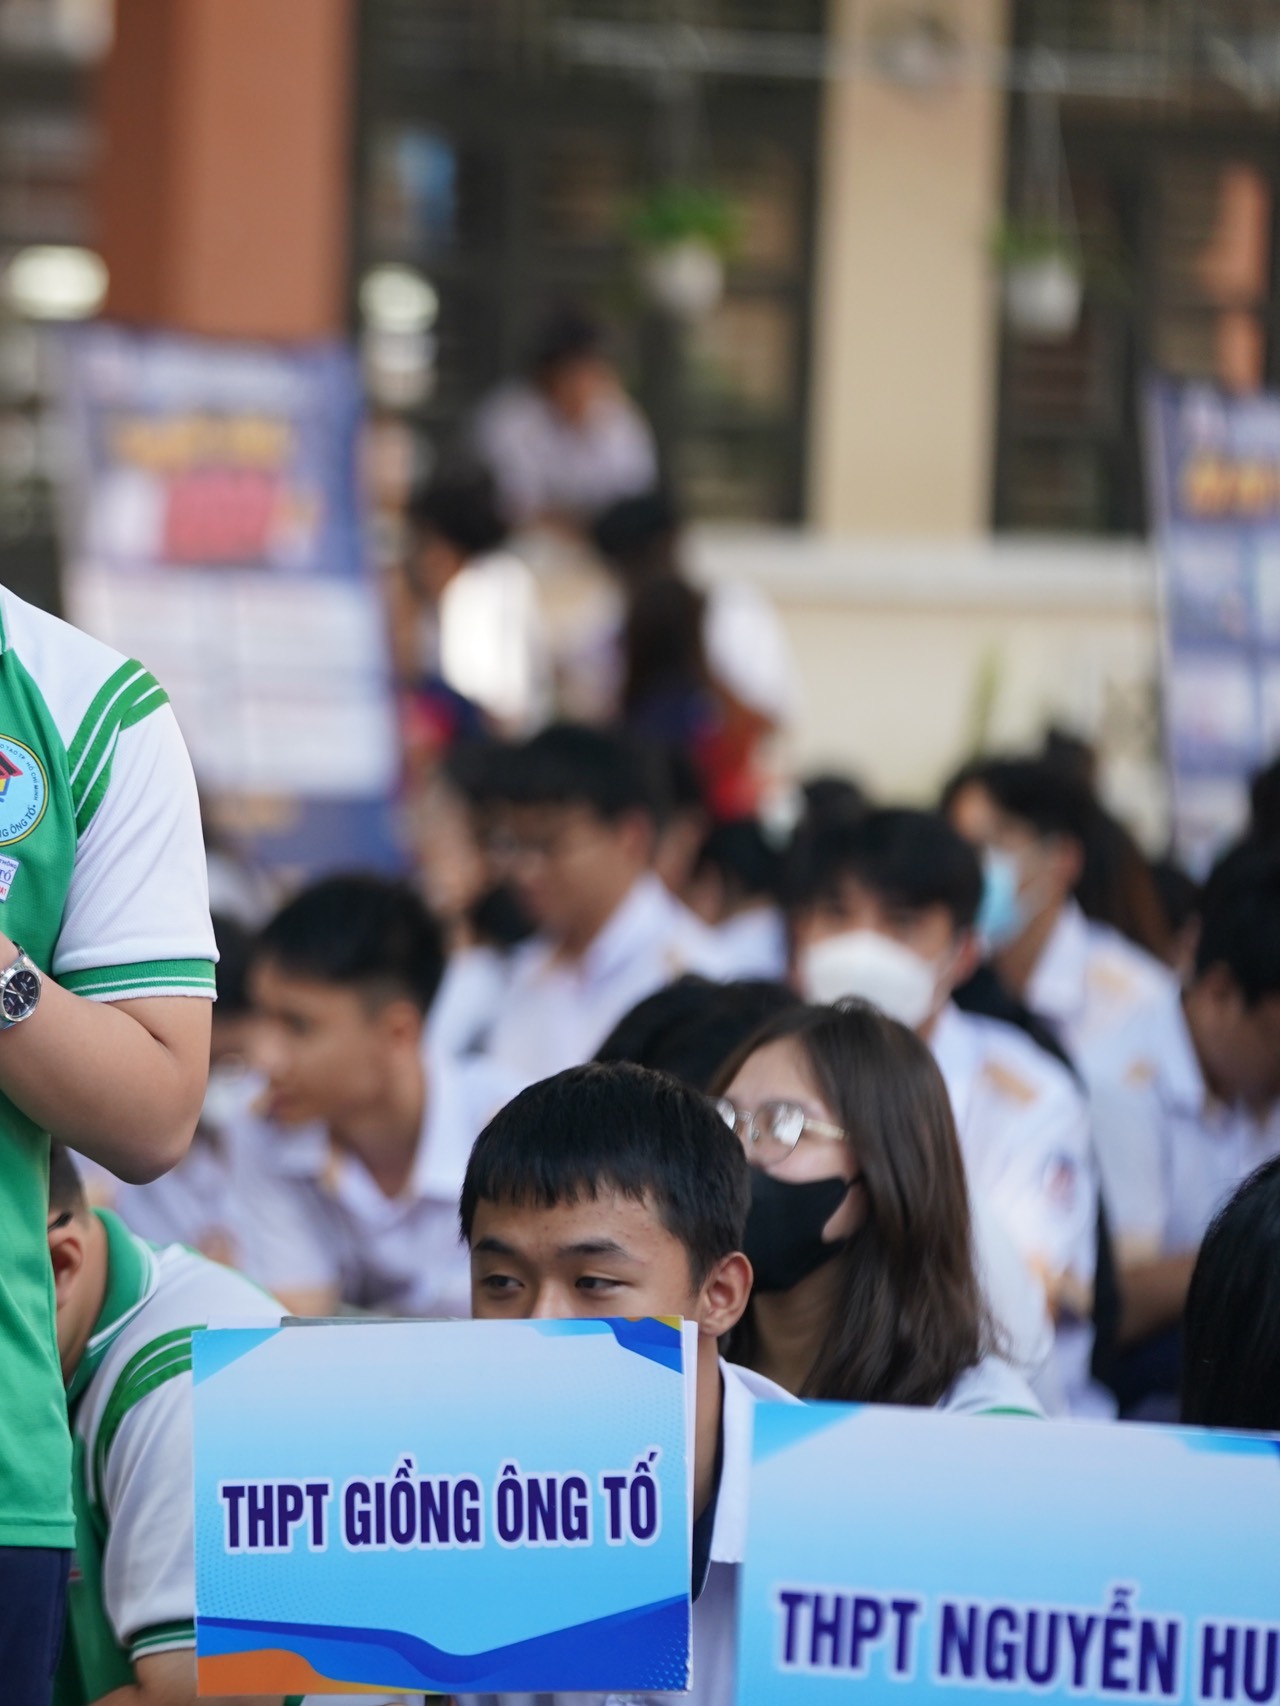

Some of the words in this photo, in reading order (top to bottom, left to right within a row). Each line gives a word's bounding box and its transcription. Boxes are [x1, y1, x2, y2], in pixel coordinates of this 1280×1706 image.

[10, 819, 28, 834] ÔNG
[222, 1483, 329, 1548] THPT
[344, 1459, 481, 1546] GIỒNG
[496, 1464, 588, 1545] ÔNG
[603, 1451, 658, 1540] TỐ
[780, 1591, 918, 1672] THPT
[940, 1587, 1178, 1695] NGUYỄN
[1202, 1624, 1279, 1703] HU
